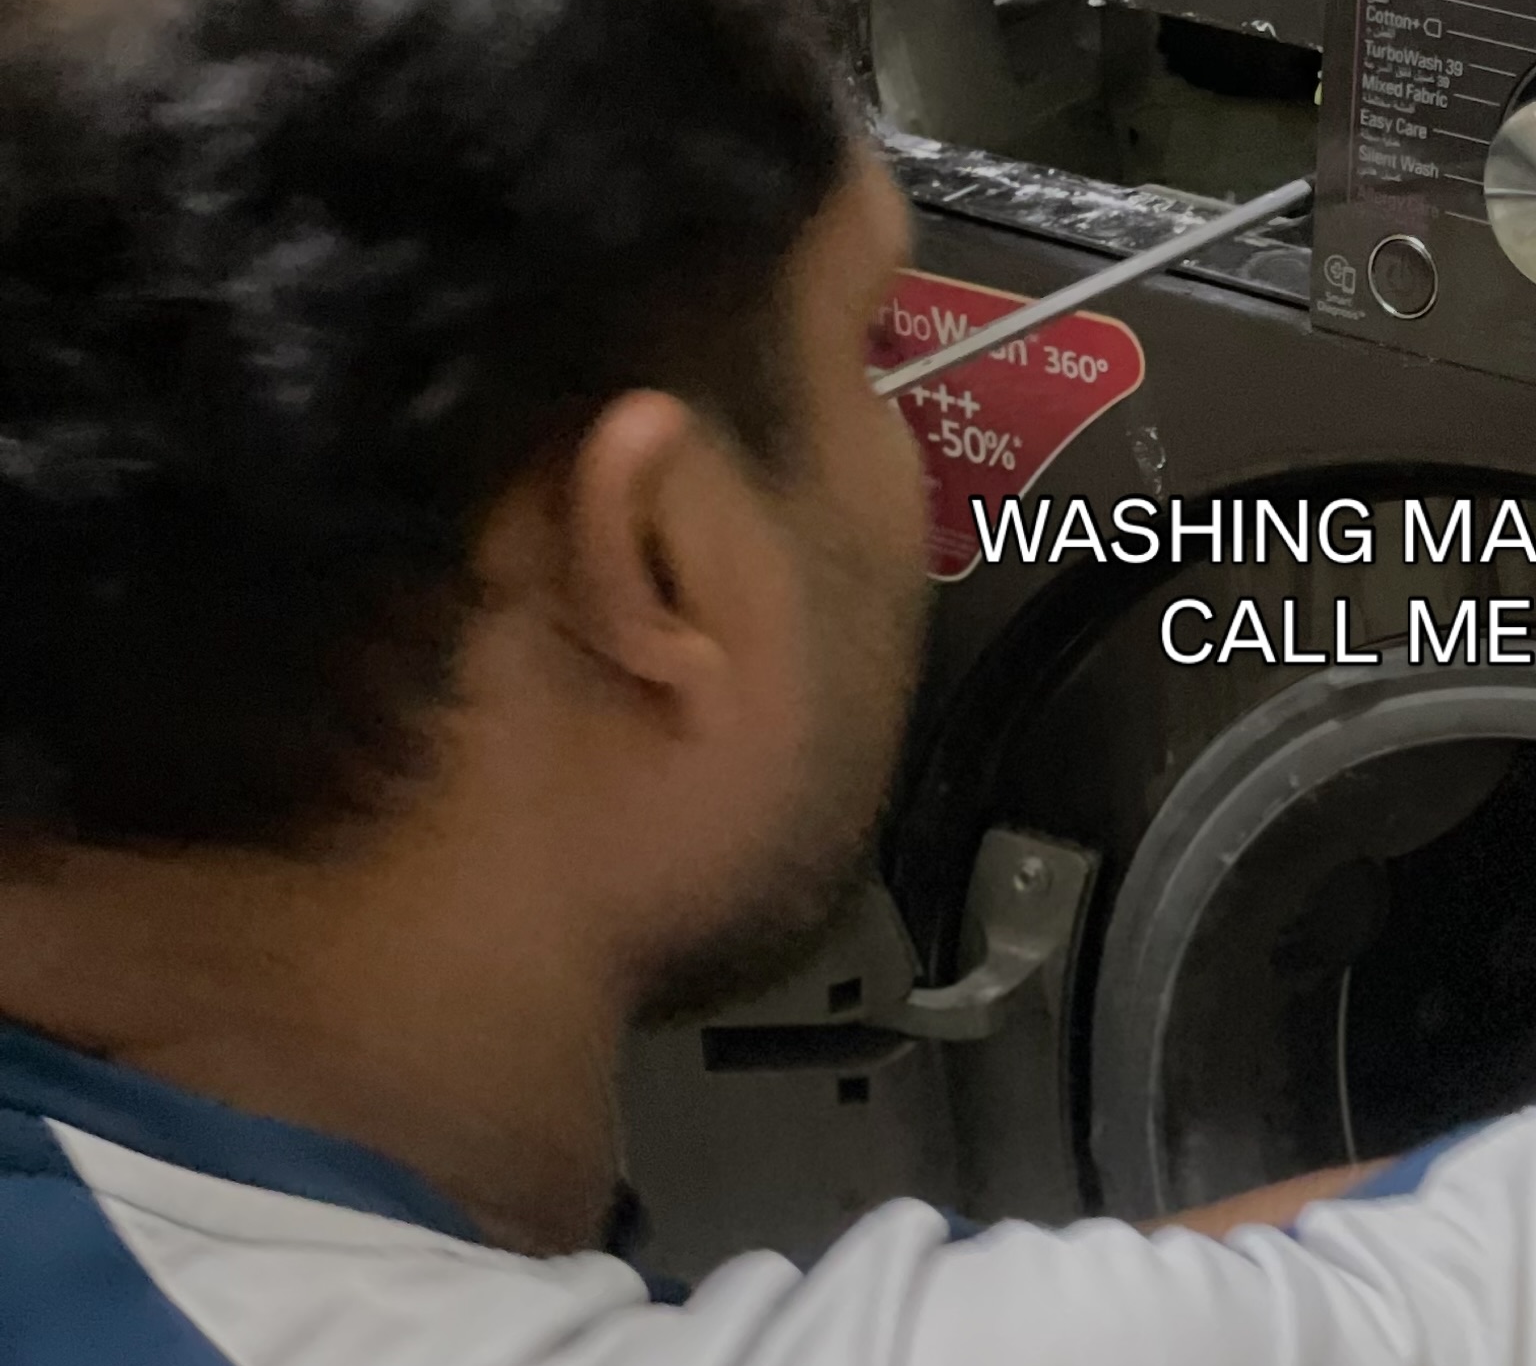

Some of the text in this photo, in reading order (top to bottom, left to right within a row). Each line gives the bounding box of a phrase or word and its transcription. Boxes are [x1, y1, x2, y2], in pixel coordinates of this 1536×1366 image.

[1365, 5, 1421, 30] Cotton+
[1364, 39, 1443, 73] TurboWash
[1445, 59, 1464, 77] 39
[1362, 73, 1403, 98] Mixed
[1405, 84, 1448, 109] Fabric
[1360, 108, 1394, 134] Easy
[1395, 117, 1428, 140] Care
[1358, 144, 1397, 170] Silent
[1400, 155, 1439, 179] Wash
